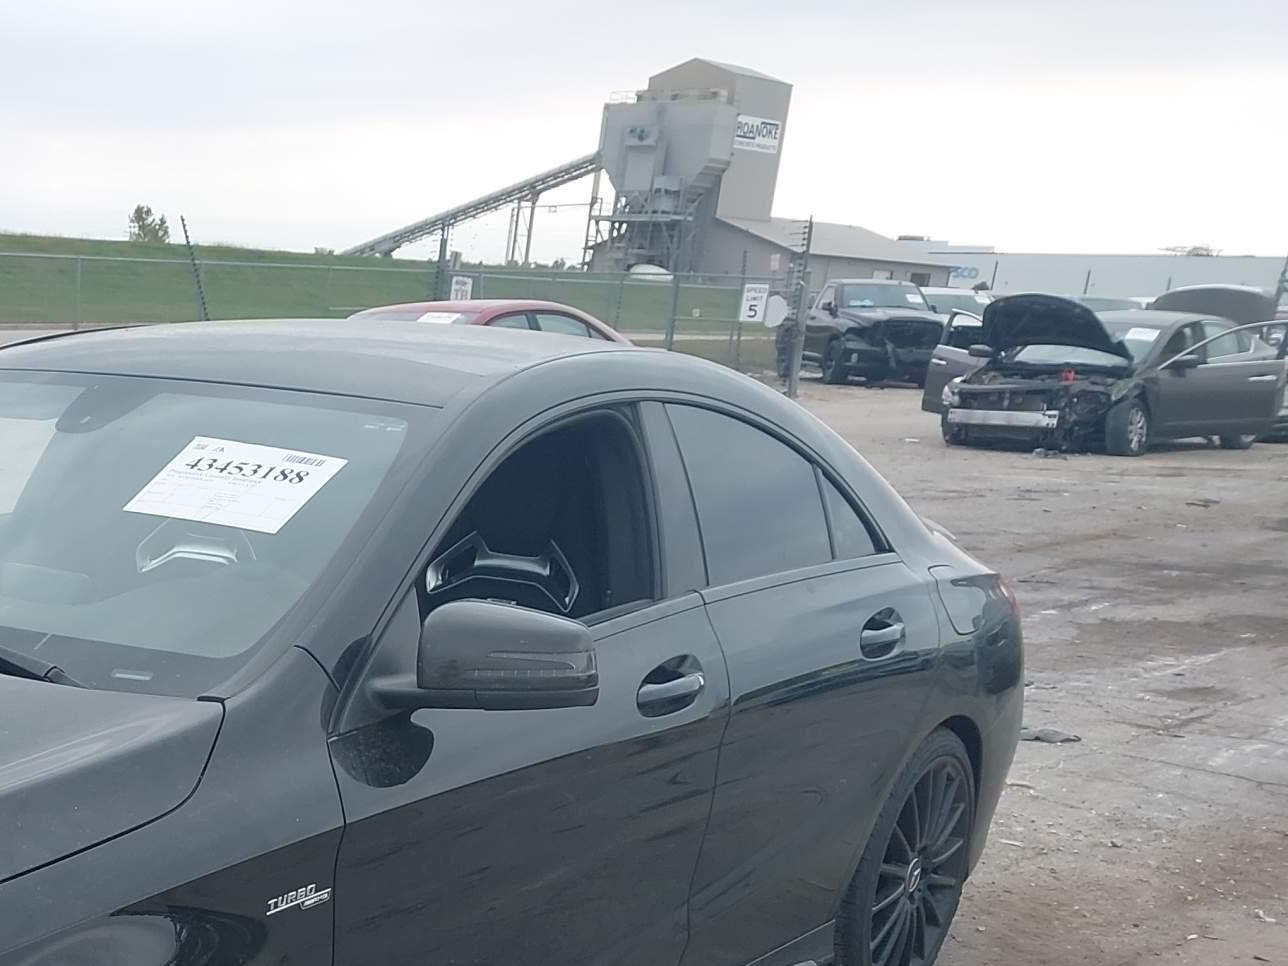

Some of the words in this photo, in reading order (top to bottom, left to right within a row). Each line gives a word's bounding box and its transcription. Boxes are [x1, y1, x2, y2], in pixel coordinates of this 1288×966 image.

[736, 120, 779, 140] ROANOKE
[746, 286, 768, 294] SPEED
[747, 303, 758, 318] 5
[185, 456, 310, 485] 43453188
[267, 883, 317, 910] TURBO
